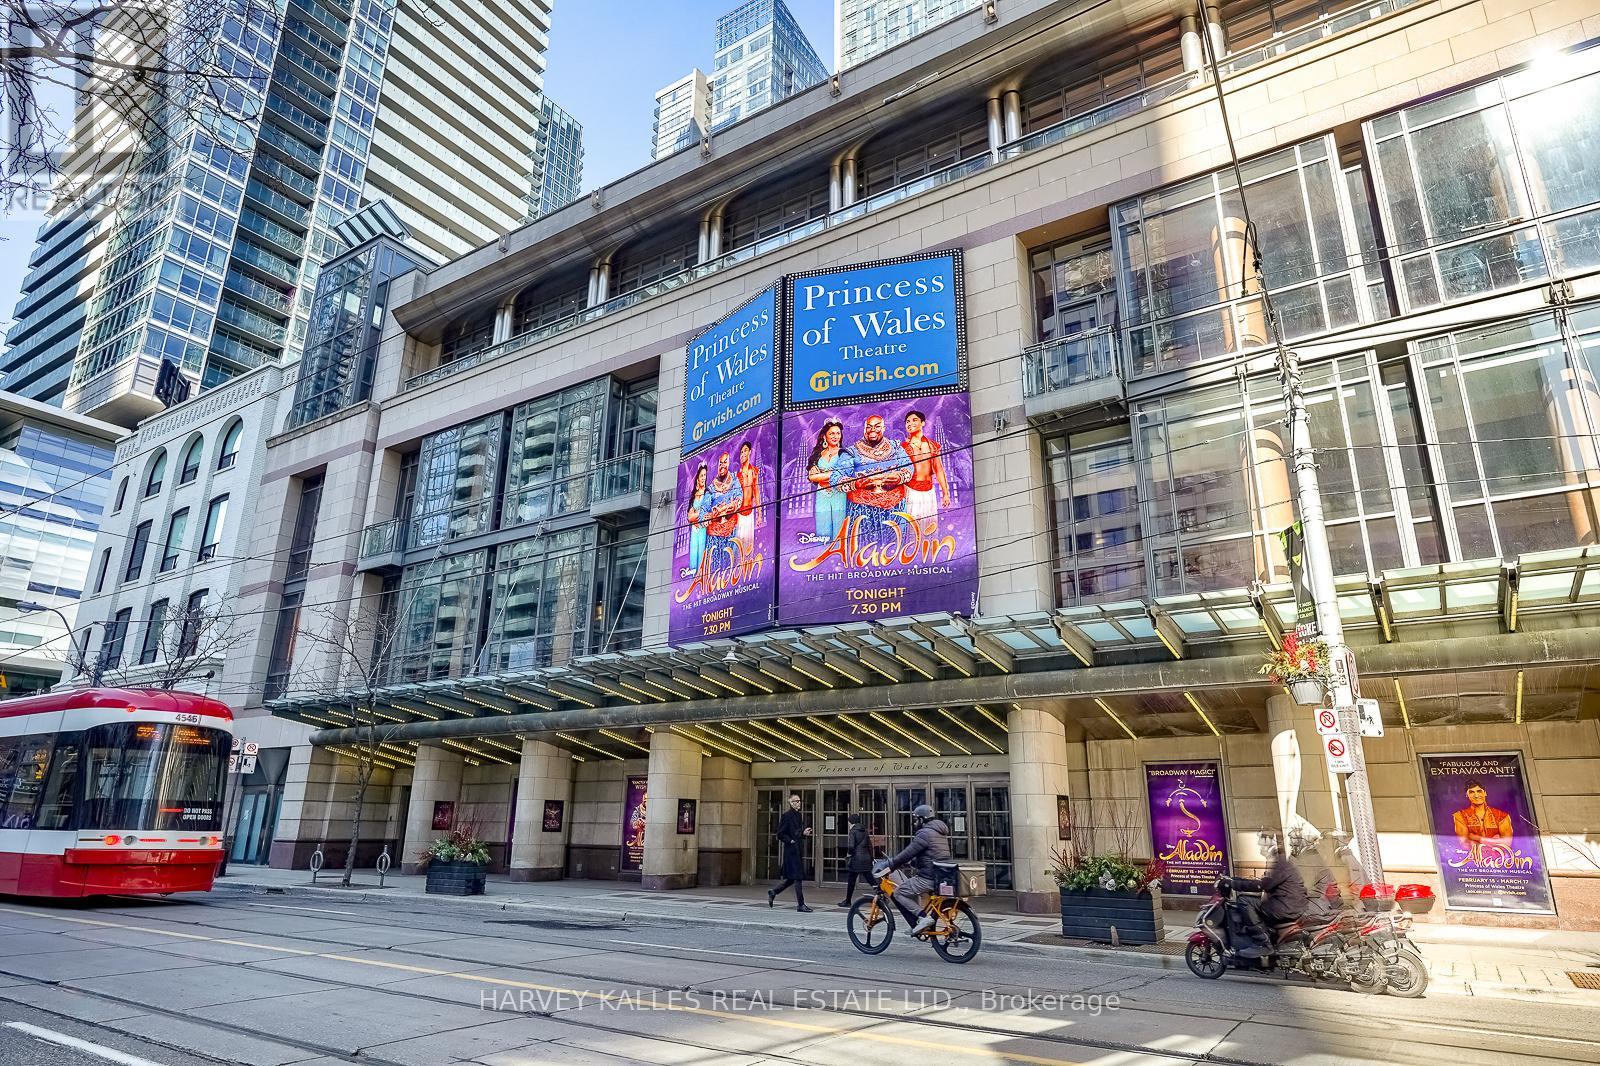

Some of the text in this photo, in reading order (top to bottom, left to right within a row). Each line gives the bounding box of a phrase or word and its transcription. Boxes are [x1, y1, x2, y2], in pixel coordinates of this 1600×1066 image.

[803, 274, 945, 311] Princess
[803, 309, 945, 346] of Wales
[691, 307, 769, 371] Princess
[839, 340, 907, 361] Theatre
[690, 342, 768, 402] of Wales
[809, 359, 939, 392] mirvish.com
[708, 378, 745, 408] Theatre
[693, 391, 761, 441] mirvish.com
[789, 512, 955, 571] Aladdin
[797, 532, 830, 544] Disney
[675, 538, 763, 603] Aladdin
[828, 572, 843, 580] HIT
[848, 569, 903, 579] BROADWAY
[908, 566, 952, 575] MUSICAL
[703, 590, 733, 604] BROADWAY
[735, 583, 759, 595] MUSICAL
[846, 588, 906, 600] TONIGHT
[702, 607, 733, 623] TONIGHT
[851, 602, 901, 614] 7.30 PM
[704, 621, 730, 635] 7.30 PM
[176, 714, 197, 723] 4546
[817, 765, 867, 773] Princess
[874, 764, 885, 773] of
[893, 763, 929, 771] Wales
[936, 761, 989, 769] Theatre
[1431, 766, 1516, 776] EXTRAVAGANT!"
[1159, 839, 1222, 861] Aladdin
[1448, 843, 1533, 869] Aladdin
